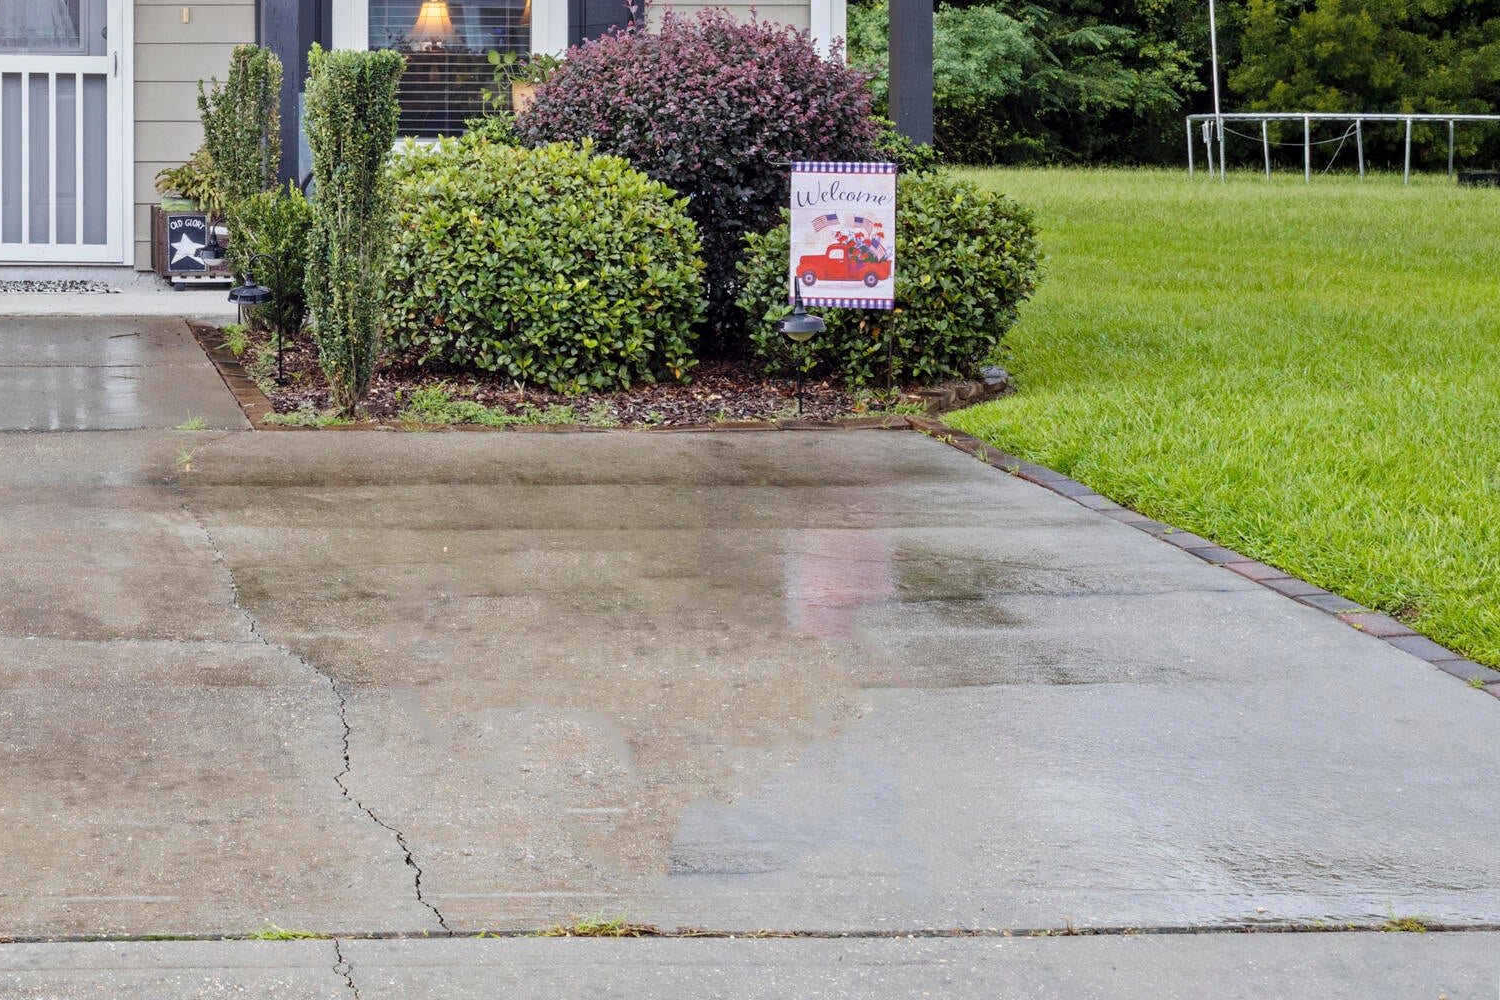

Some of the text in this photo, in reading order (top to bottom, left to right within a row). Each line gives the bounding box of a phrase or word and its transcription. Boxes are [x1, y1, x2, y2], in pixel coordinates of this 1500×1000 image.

[796, 180, 893, 208] Welcome
[170, 218, 205, 230] OLD GLORY
